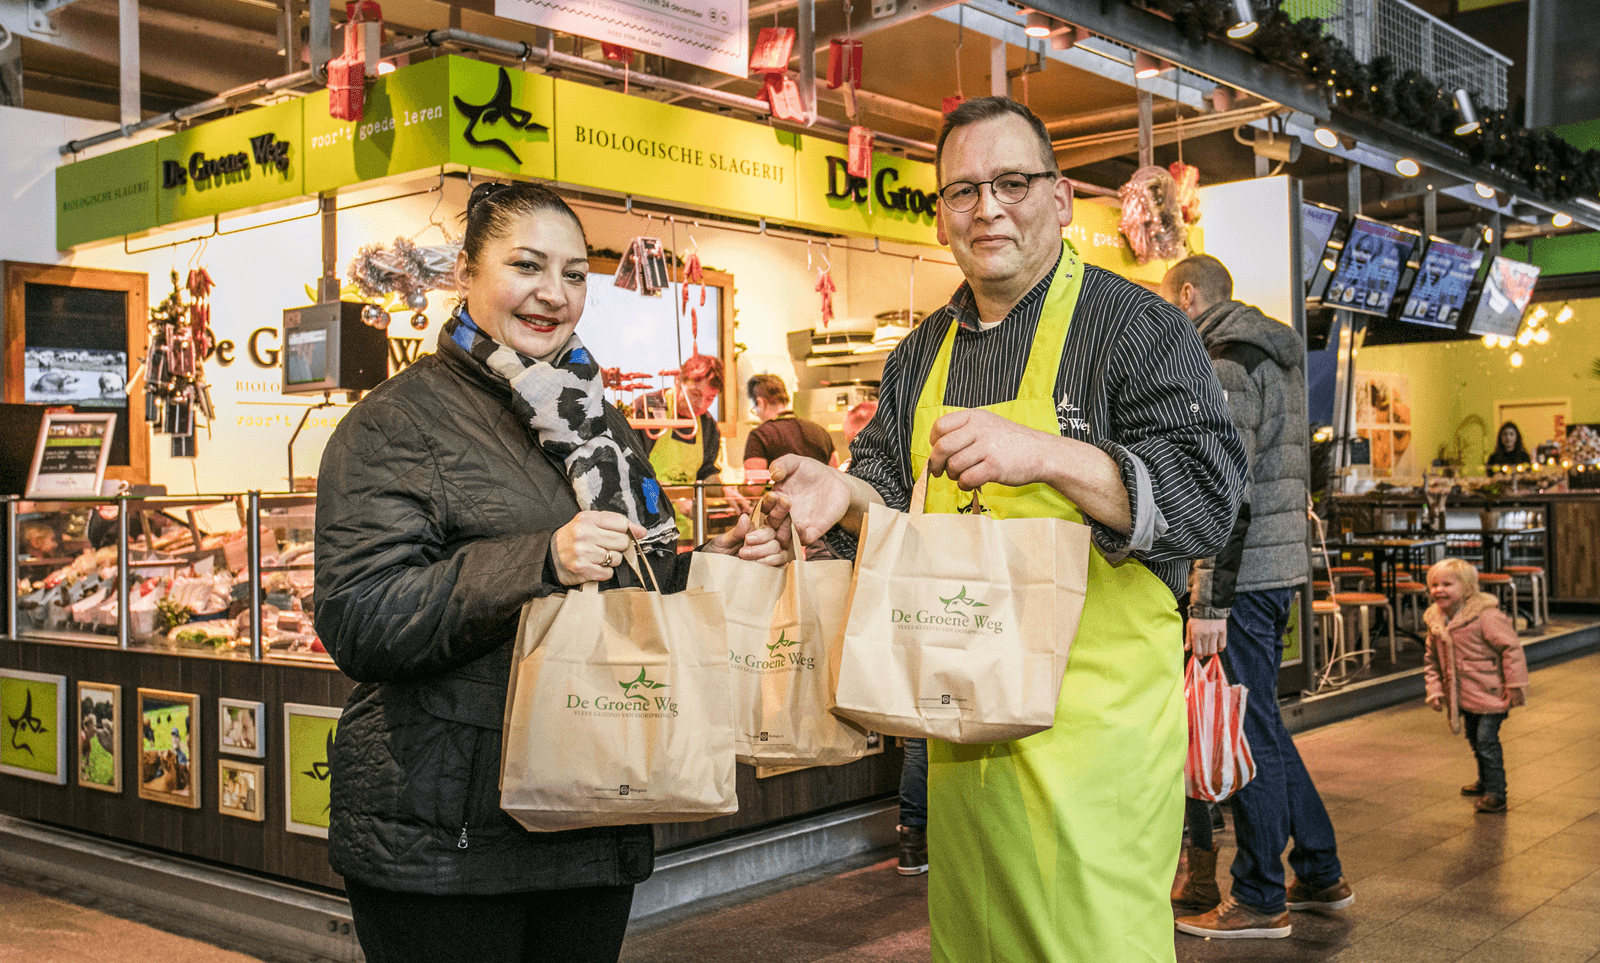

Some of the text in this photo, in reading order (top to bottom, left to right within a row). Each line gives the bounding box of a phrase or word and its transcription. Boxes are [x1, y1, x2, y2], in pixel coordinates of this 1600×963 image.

[671, 3, 703, 18] december
[311, 105, 442, 149] voor't goede leven
[163, 132, 290, 189] De Groene Weg
[576, 125, 784, 184] BIOLOGISCHE SLAGERIJ
[825, 156, 938, 217] De Groe
[236, 414, 337, 430] voor't goed
[891, 608, 1003, 634] De Groene Weg
[954, 628, 989, 636] OORSPRONG
[745, 654, 786, 669] Groene
[788, 652, 815, 670] Weg
[566, 694, 589, 709] De
[594, 696, 650, 711] Groene
